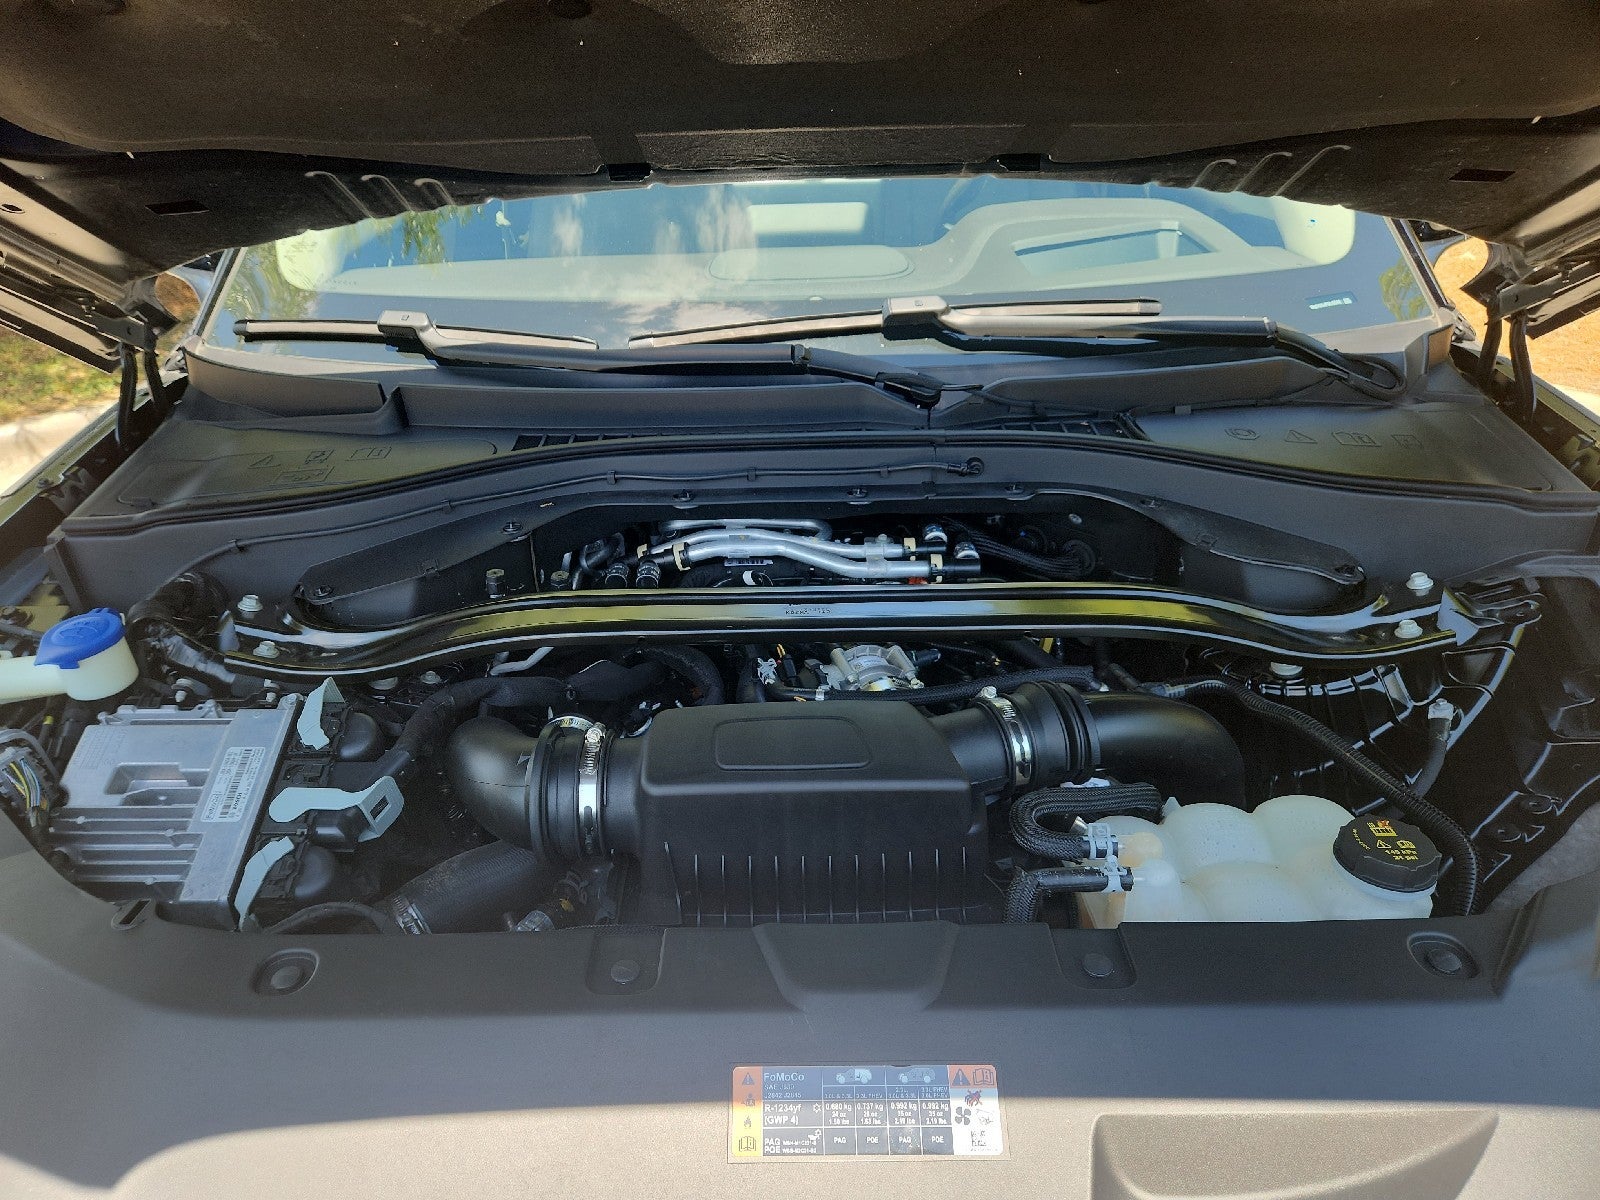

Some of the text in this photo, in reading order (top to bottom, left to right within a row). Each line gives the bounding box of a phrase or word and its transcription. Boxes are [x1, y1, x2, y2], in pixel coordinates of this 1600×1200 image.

[763, 1072, 805, 1082] FoMoCo
[764, 1103, 802, 1114] R-1234yf
[856, 1102, 884, 1112] 0.737 kg
[908, 1101, 918, 1112] kg
[940, 1101, 950, 1112] kg
[763, 1114, 799, 1126] (GWP 4)
[764, 1137, 781, 1146] PAG
[833, 1136, 847, 1144] PAG
[866, 1136, 879, 1144] POE
[898, 1136, 912, 1144] PAG
[931, 1135, 945, 1143] POE
[764, 1145, 781, 1154] POE
